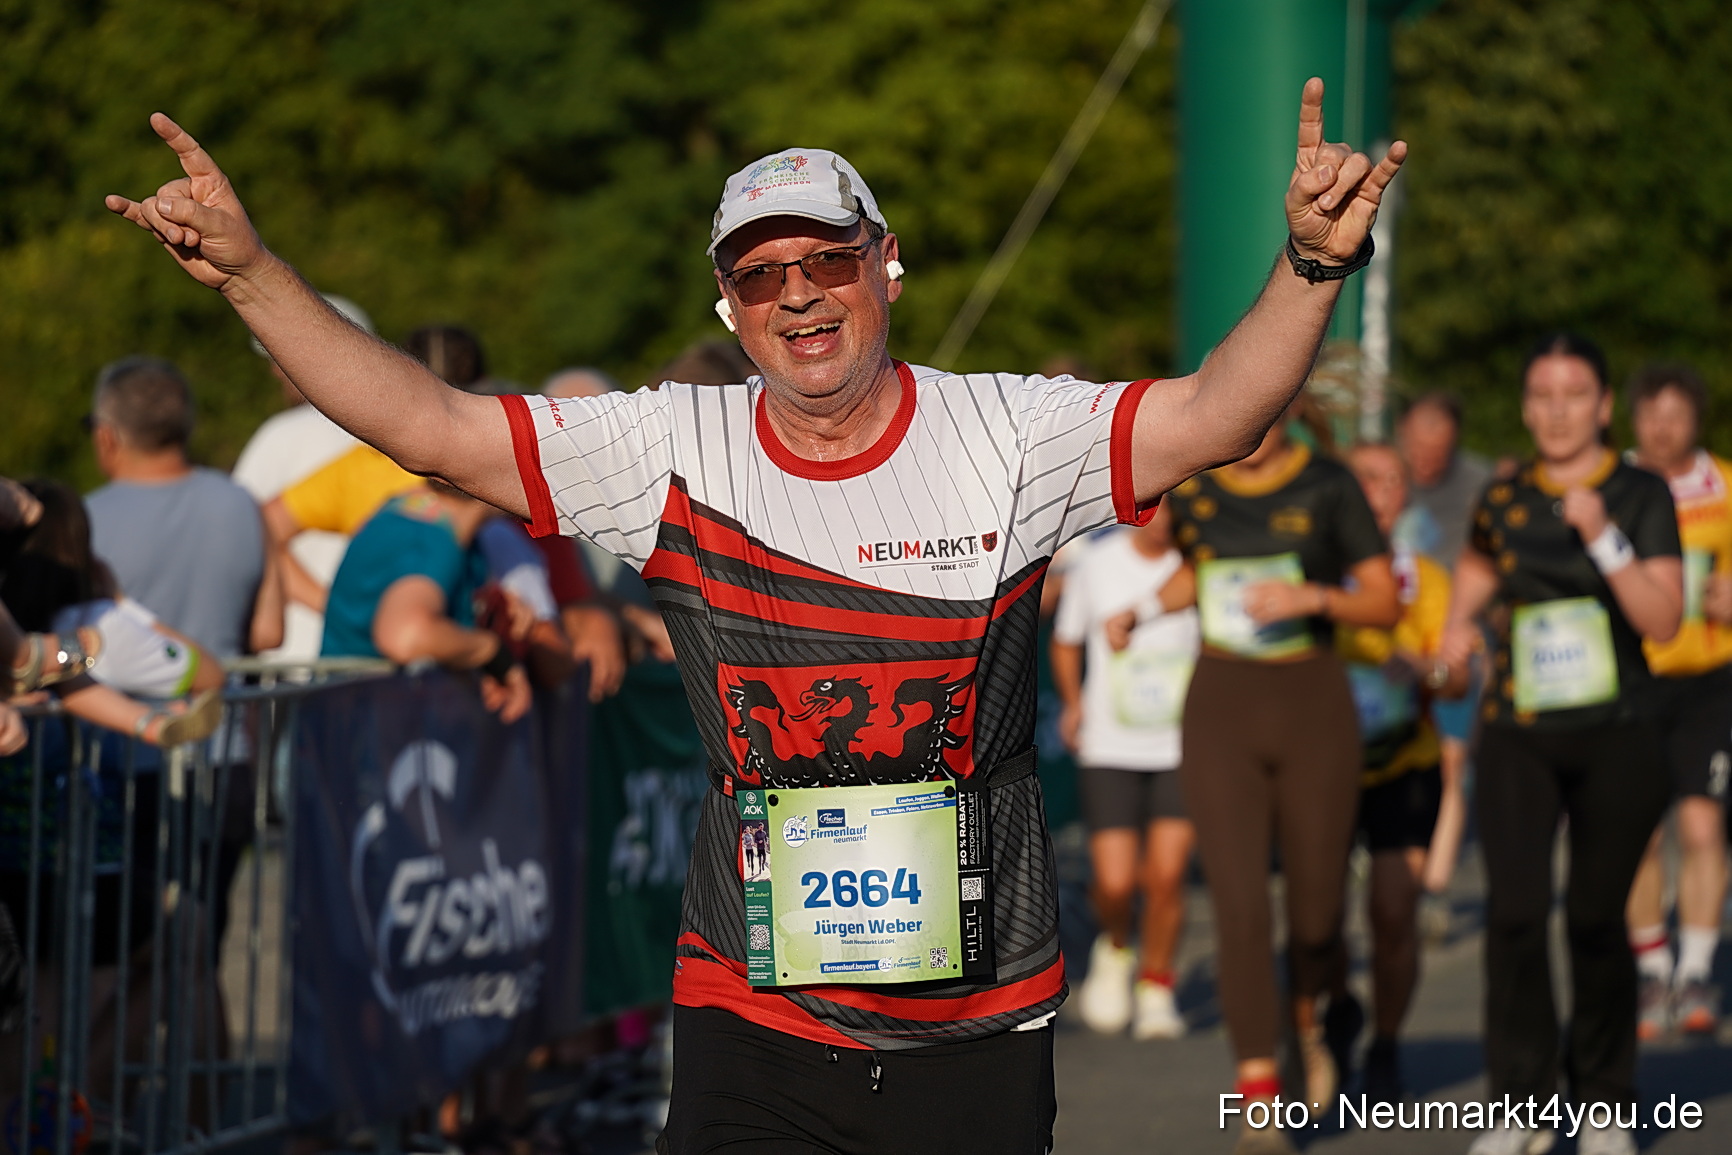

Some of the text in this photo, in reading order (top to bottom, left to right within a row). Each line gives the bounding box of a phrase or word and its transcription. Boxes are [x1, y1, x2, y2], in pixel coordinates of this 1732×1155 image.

[765, 180, 811, 191] MARATHON
[857, 535, 977, 563] NEUMARKT
[931, 561, 980, 572] STARKE STADT
[743, 805, 764, 815] AOK
[810, 824, 868, 839] Firmenlauf
[958, 791, 968, 866] 20 % RABATT
[968, 792, 976, 865] FACTORY OUTLET
[833, 834, 867, 843] neumarkt
[801, 867, 922, 909] 2664
[813, 918, 923, 938] Jürgen Weber
[965, 905, 978, 962] HILTL
[823, 962, 876, 972] firmenlauf.bayern
